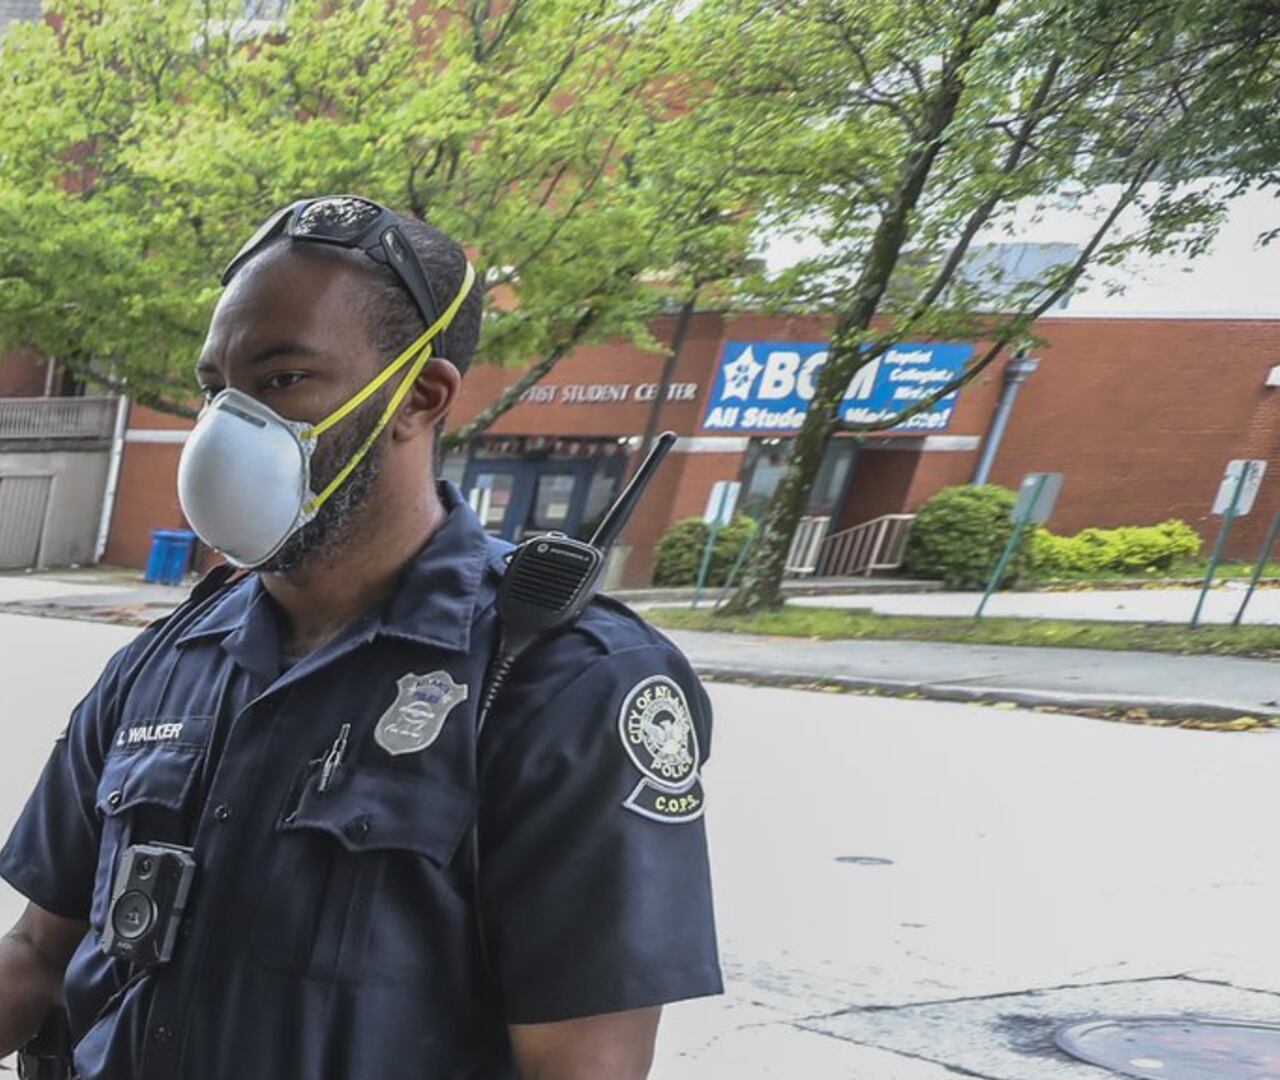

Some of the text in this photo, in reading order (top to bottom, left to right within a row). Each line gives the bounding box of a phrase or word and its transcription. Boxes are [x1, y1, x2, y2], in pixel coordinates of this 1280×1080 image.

[883, 350, 933, 367] Baptist
[560, 384, 632, 402] STUDENT
[634, 382, 699, 401] CETER
[703, 408, 740, 429] All
[739, 407, 812, 429] Stude
[628, 709, 643, 745] CITY
[636, 689, 653, 710] OF
[127, 722, 184, 745] WALKER
